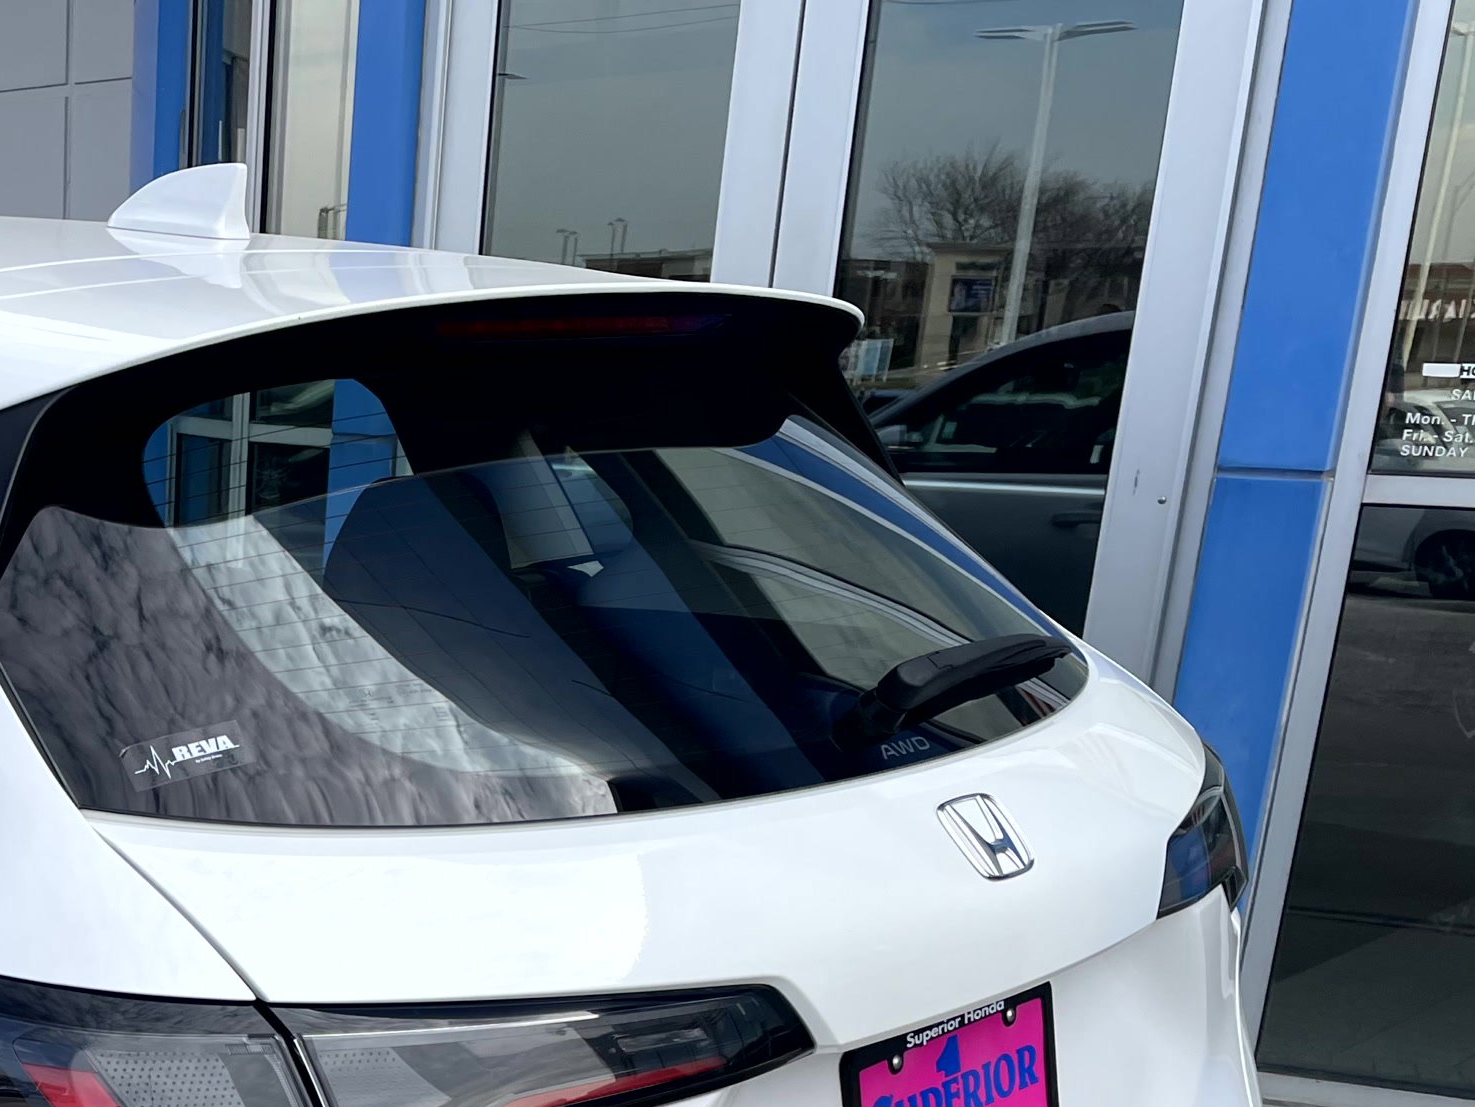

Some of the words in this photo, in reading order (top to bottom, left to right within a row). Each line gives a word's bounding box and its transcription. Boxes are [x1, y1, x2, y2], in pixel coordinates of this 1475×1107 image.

[1460, 366, 1475, 377] H
[1405, 412, 1445, 425] Mon.
[1442, 430, 1474, 443] Sat.
[1400, 444, 1469, 457] SUNDAY
[172, 735, 236, 762] REVA
[881, 736, 931, 760] AWD
[906, 1016, 962, 1048] Superior
[964, 1000, 1005, 1024] Honda
